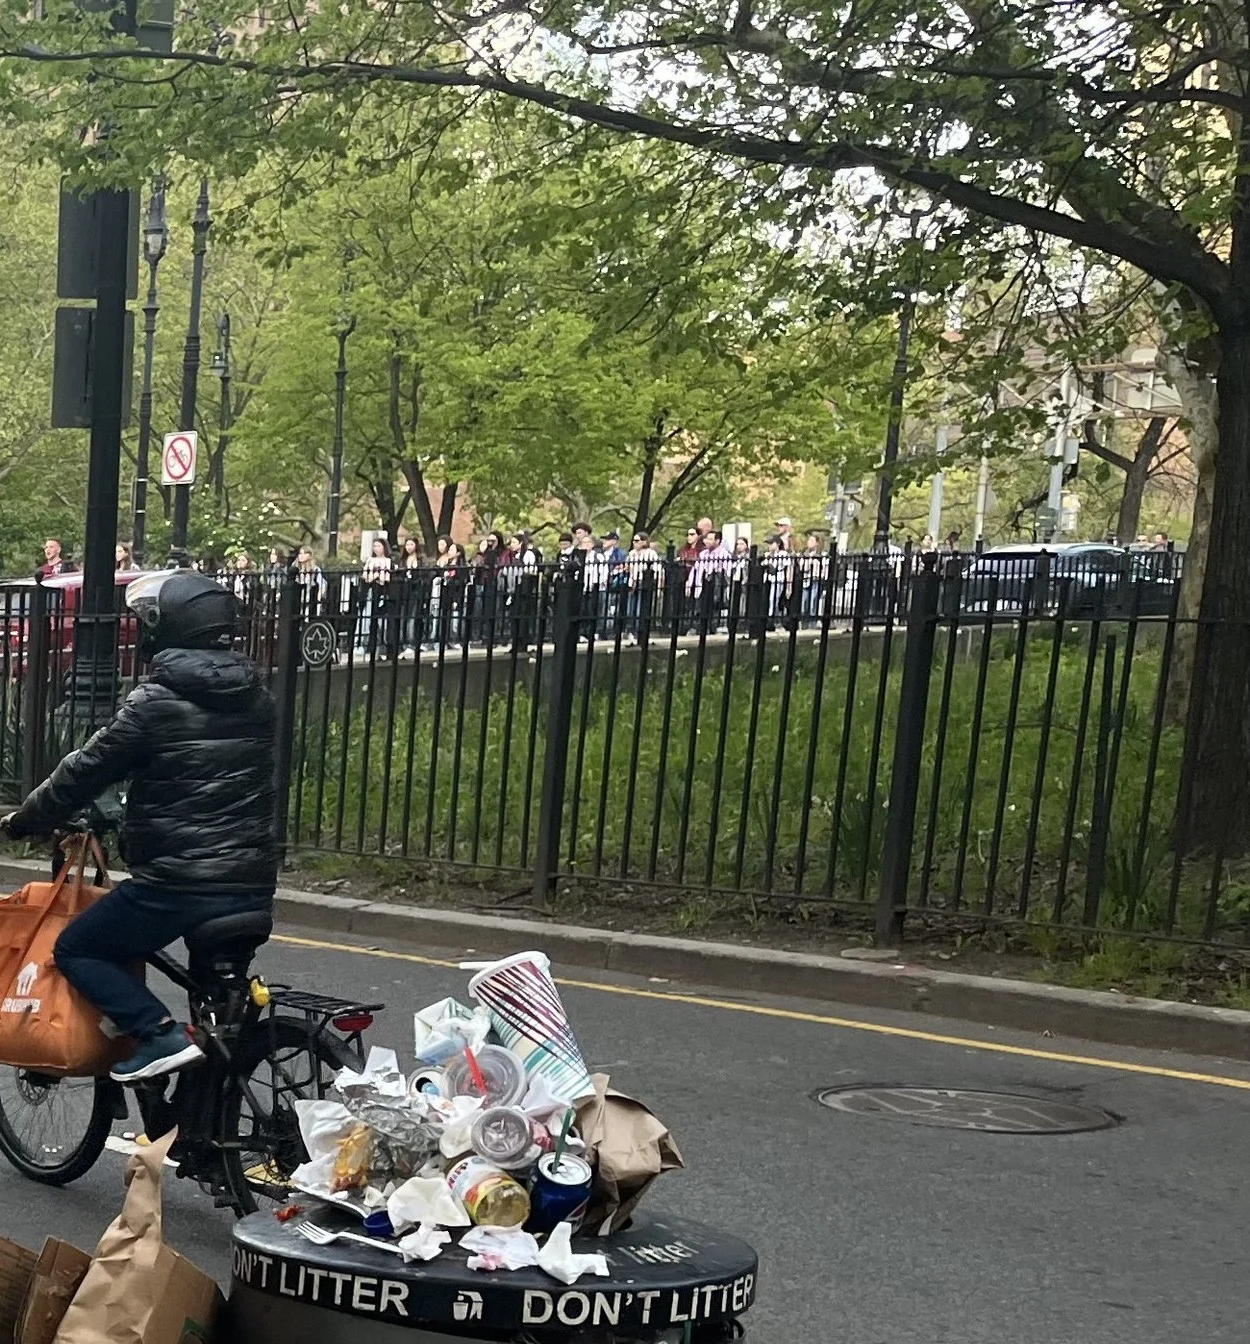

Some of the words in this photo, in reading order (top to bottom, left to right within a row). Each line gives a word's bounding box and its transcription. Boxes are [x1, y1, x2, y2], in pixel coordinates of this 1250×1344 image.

[279, 1262, 409, 1316] LITTER
[522, 1289, 660, 1325] DON'T
[670, 1273, 754, 1323] LITTER
